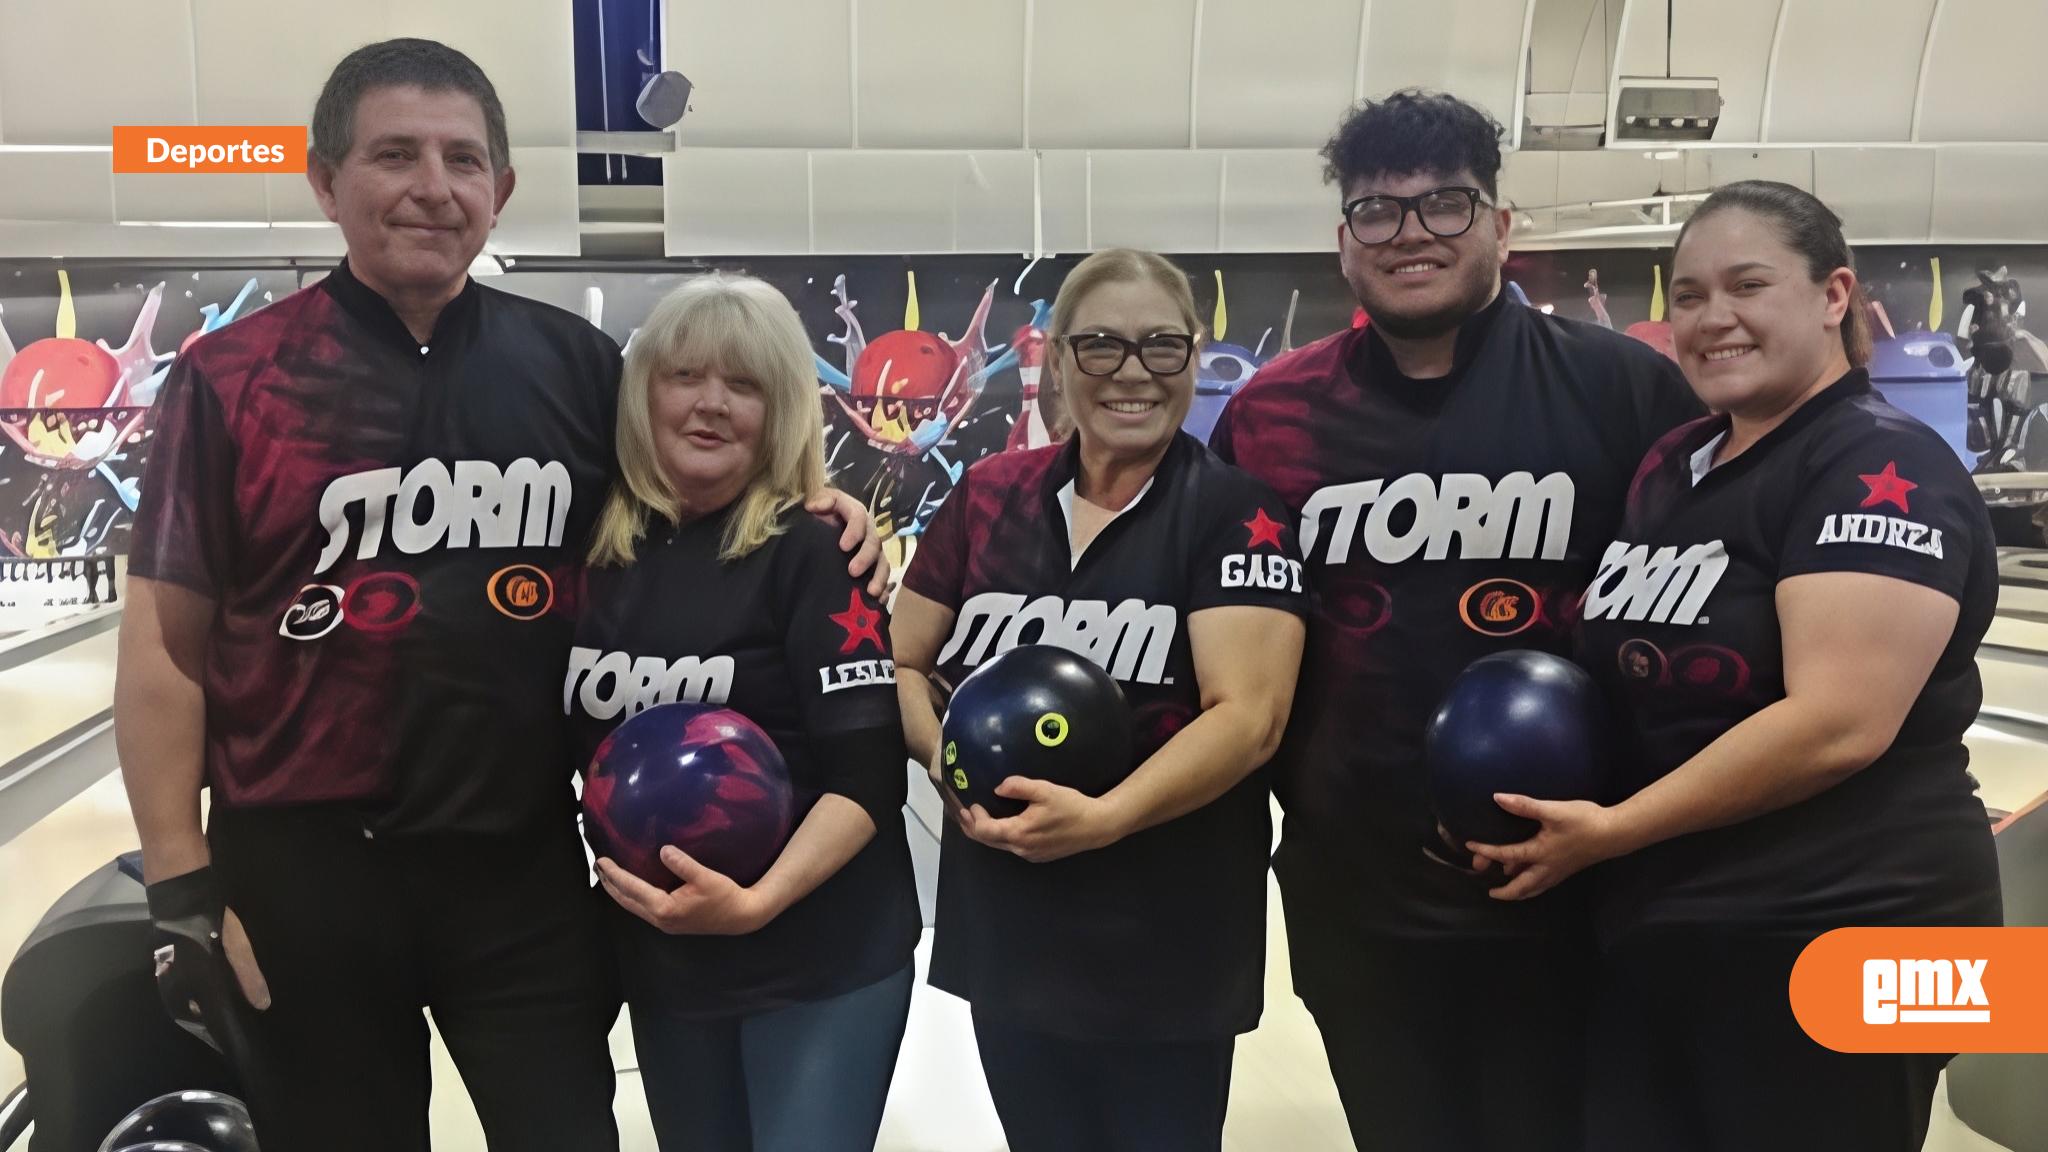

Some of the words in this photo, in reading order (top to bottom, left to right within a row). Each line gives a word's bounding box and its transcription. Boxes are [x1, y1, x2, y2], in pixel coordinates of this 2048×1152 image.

[314, 457, 572, 575] STORM
[1299, 471, 1575, 564] STORM
[936, 592, 1177, 685] STORM
